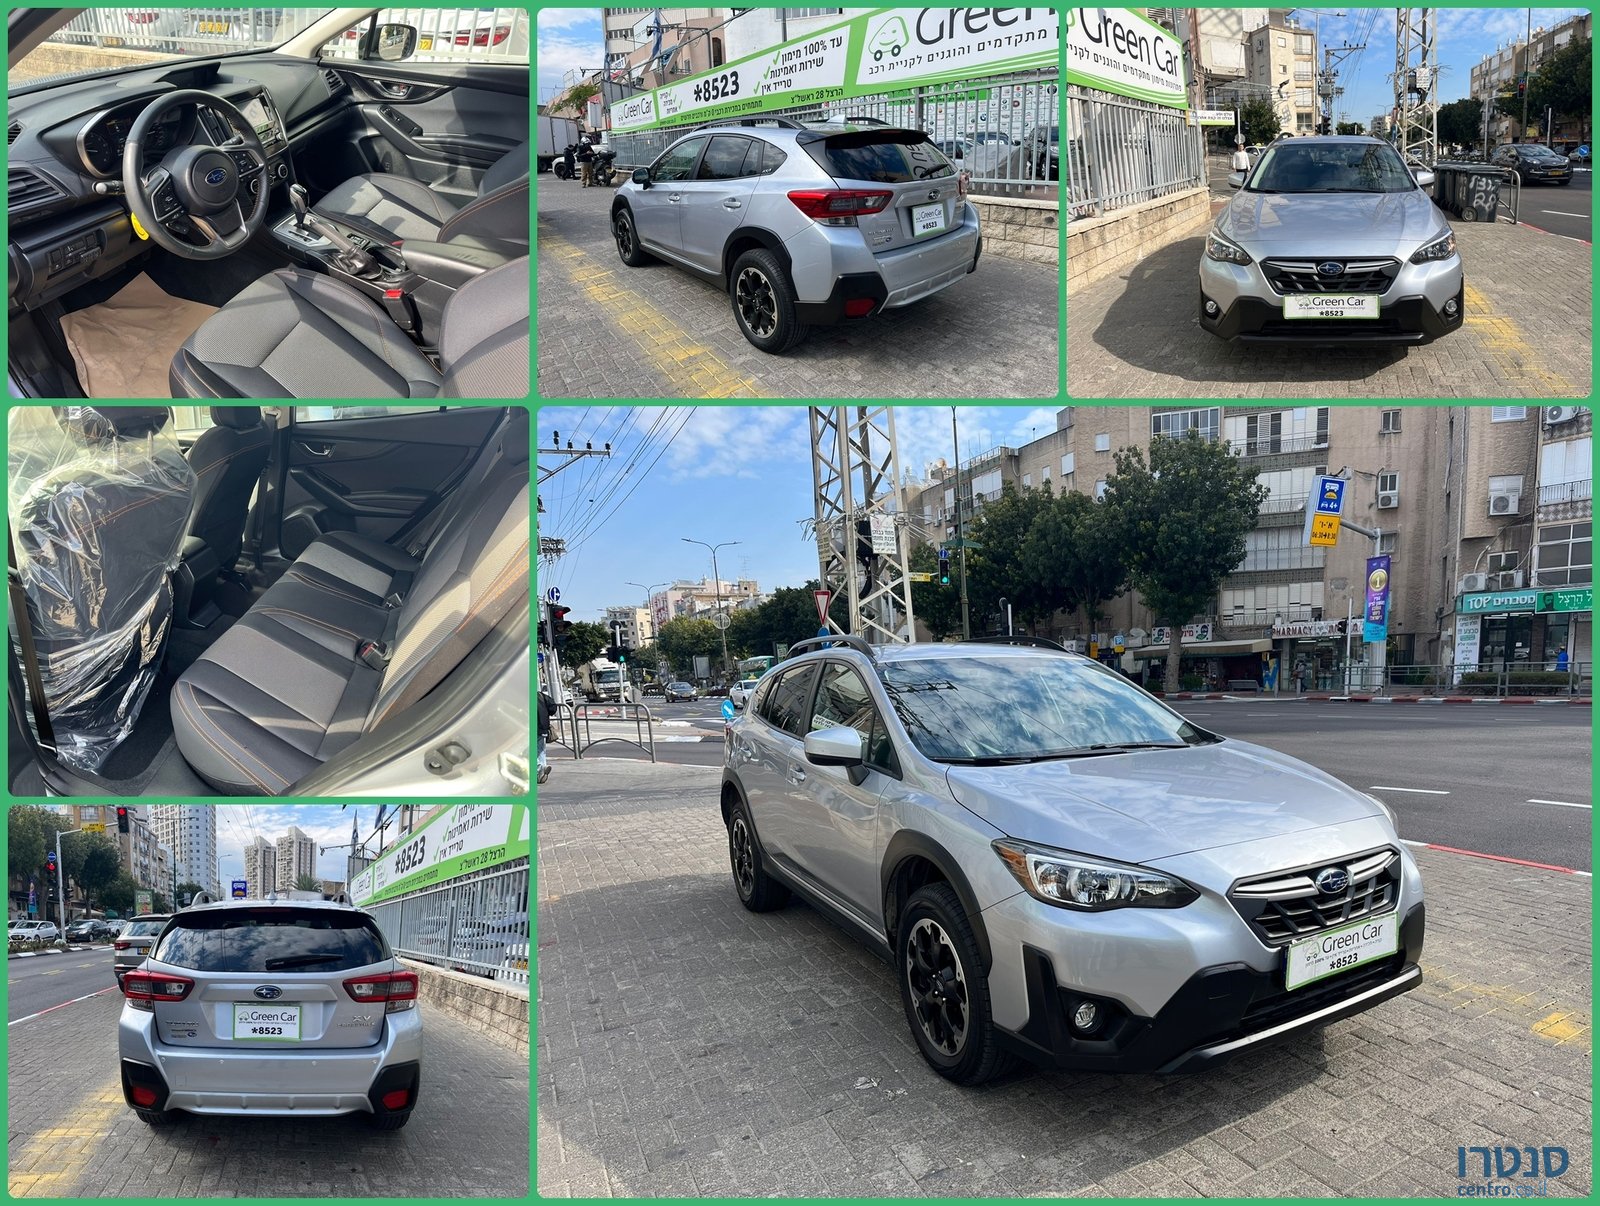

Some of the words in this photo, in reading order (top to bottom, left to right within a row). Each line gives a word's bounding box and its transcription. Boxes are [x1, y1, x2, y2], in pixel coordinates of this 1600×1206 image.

[830, 36, 842, 48] עד
[978, 28, 1047, 52] מתקדמים
[1080, 8, 1150, 65] Green
[1154, 36, 1178, 77] Car
[804, 40, 828, 56] 100%
[928, 45, 970, 63] והוגנים
[782, 49, 802, 66] מימון
[799, 56, 824, 72] שירות
[888, 54, 922, 72] לקניית
[1094, 52, 1121, 72] והוגנים
[770, 64, 797, 79] ואמינות
[868, 64, 885, 75] רכב
[1122, 64, 1150, 82] מתקדמים
[773, 79, 792, 91] טרייד
[1151, 76, 1164, 86] מימון
[762, 84, 772, 96] אין
[816, 90, 824, 100] 28
[826, 88, 843, 100] הרצל
[920, 210, 935, 220] Green
[1312, 297, 1344, 306] Green
[1346, 297, 1366, 306] Car
[1468, 596, 1491, 610] TOP
[1272, 626, 1313, 636] PHARMACY
[470, 806, 493, 829] שירות
[447, 822, 470, 842] ואמינות
[448, 840, 463, 855] טרייד
[488, 847, 505, 862] הרצל
[438, 848, 447, 863] אין
[480, 852, 488, 863] 28
[1322, 932, 1360, 954] Green
[1362, 924, 1383, 940] Car
[251, 1011, 279, 1022] Green
[281, 1012, 296, 1022] Car
